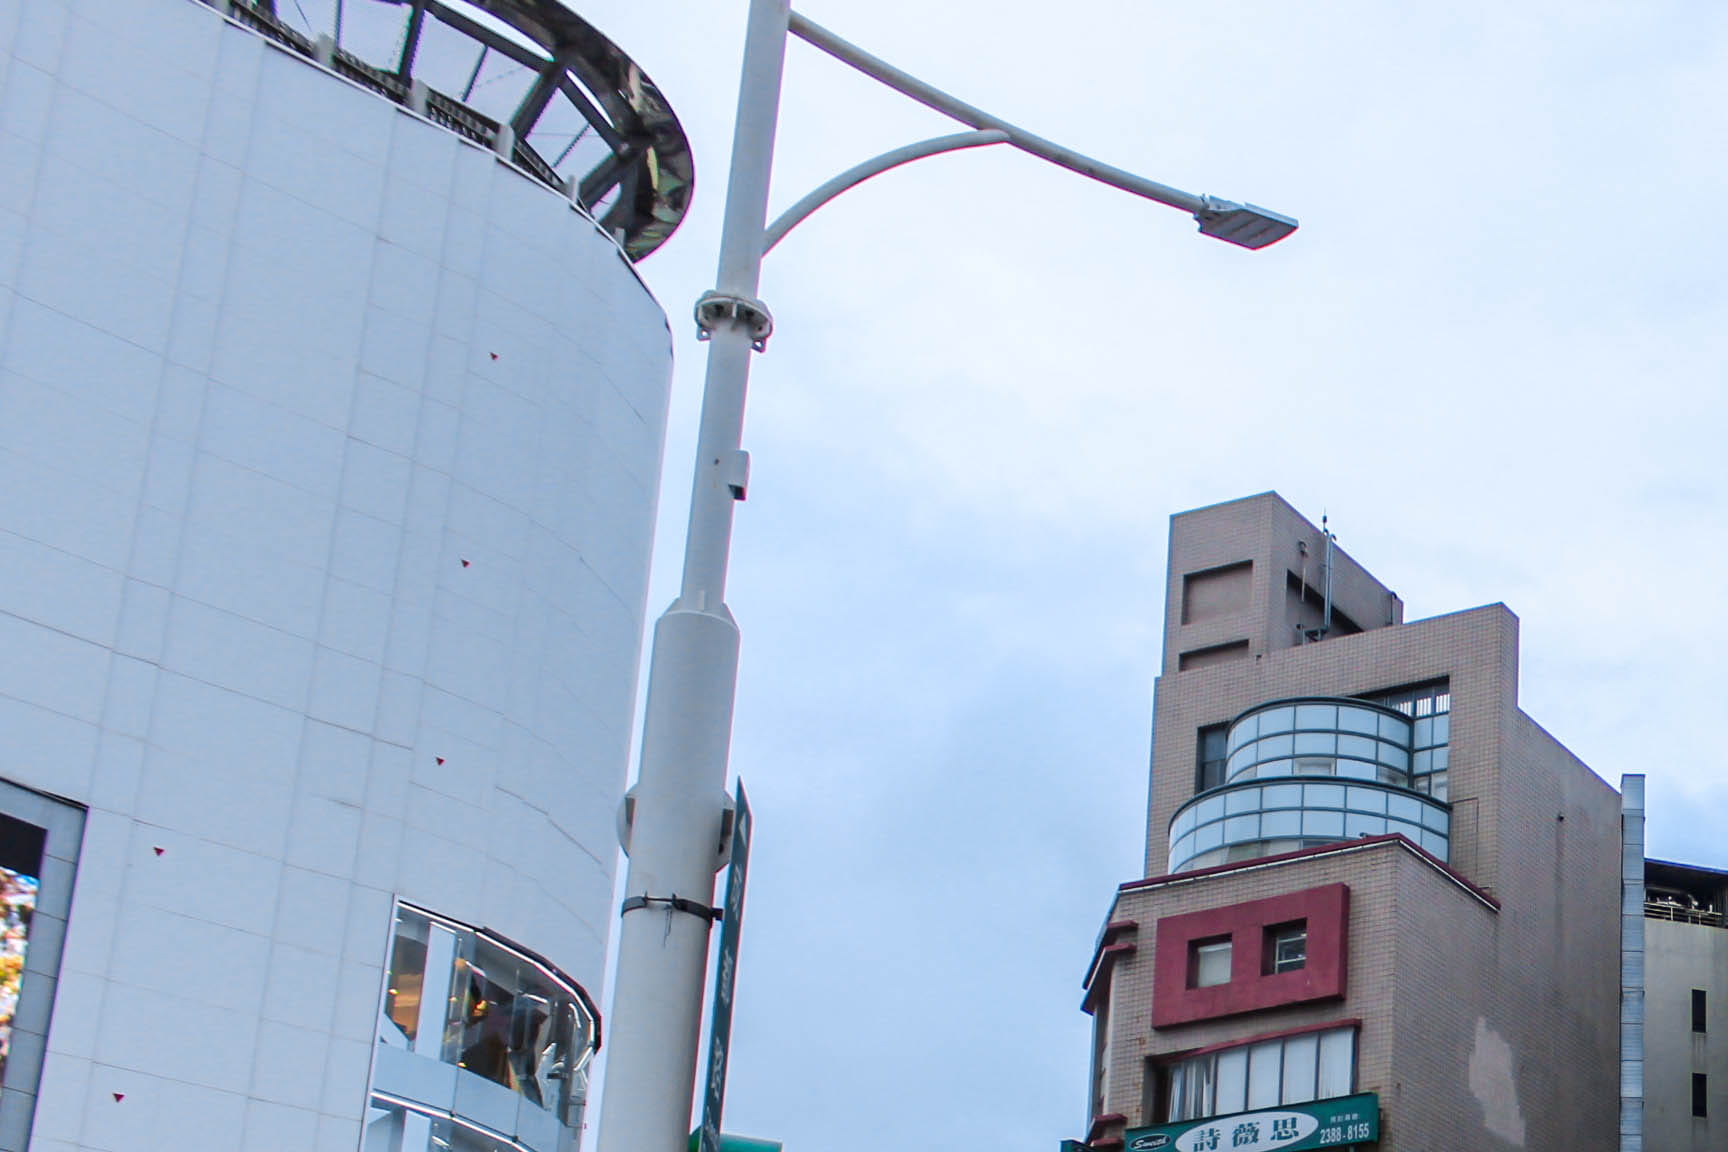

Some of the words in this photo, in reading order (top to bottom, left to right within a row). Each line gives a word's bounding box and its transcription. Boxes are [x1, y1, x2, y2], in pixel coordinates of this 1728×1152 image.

[1192, 1116, 1300, 1152] 詩薇思
[1319, 1123, 1370, 1145] 2388-8155
